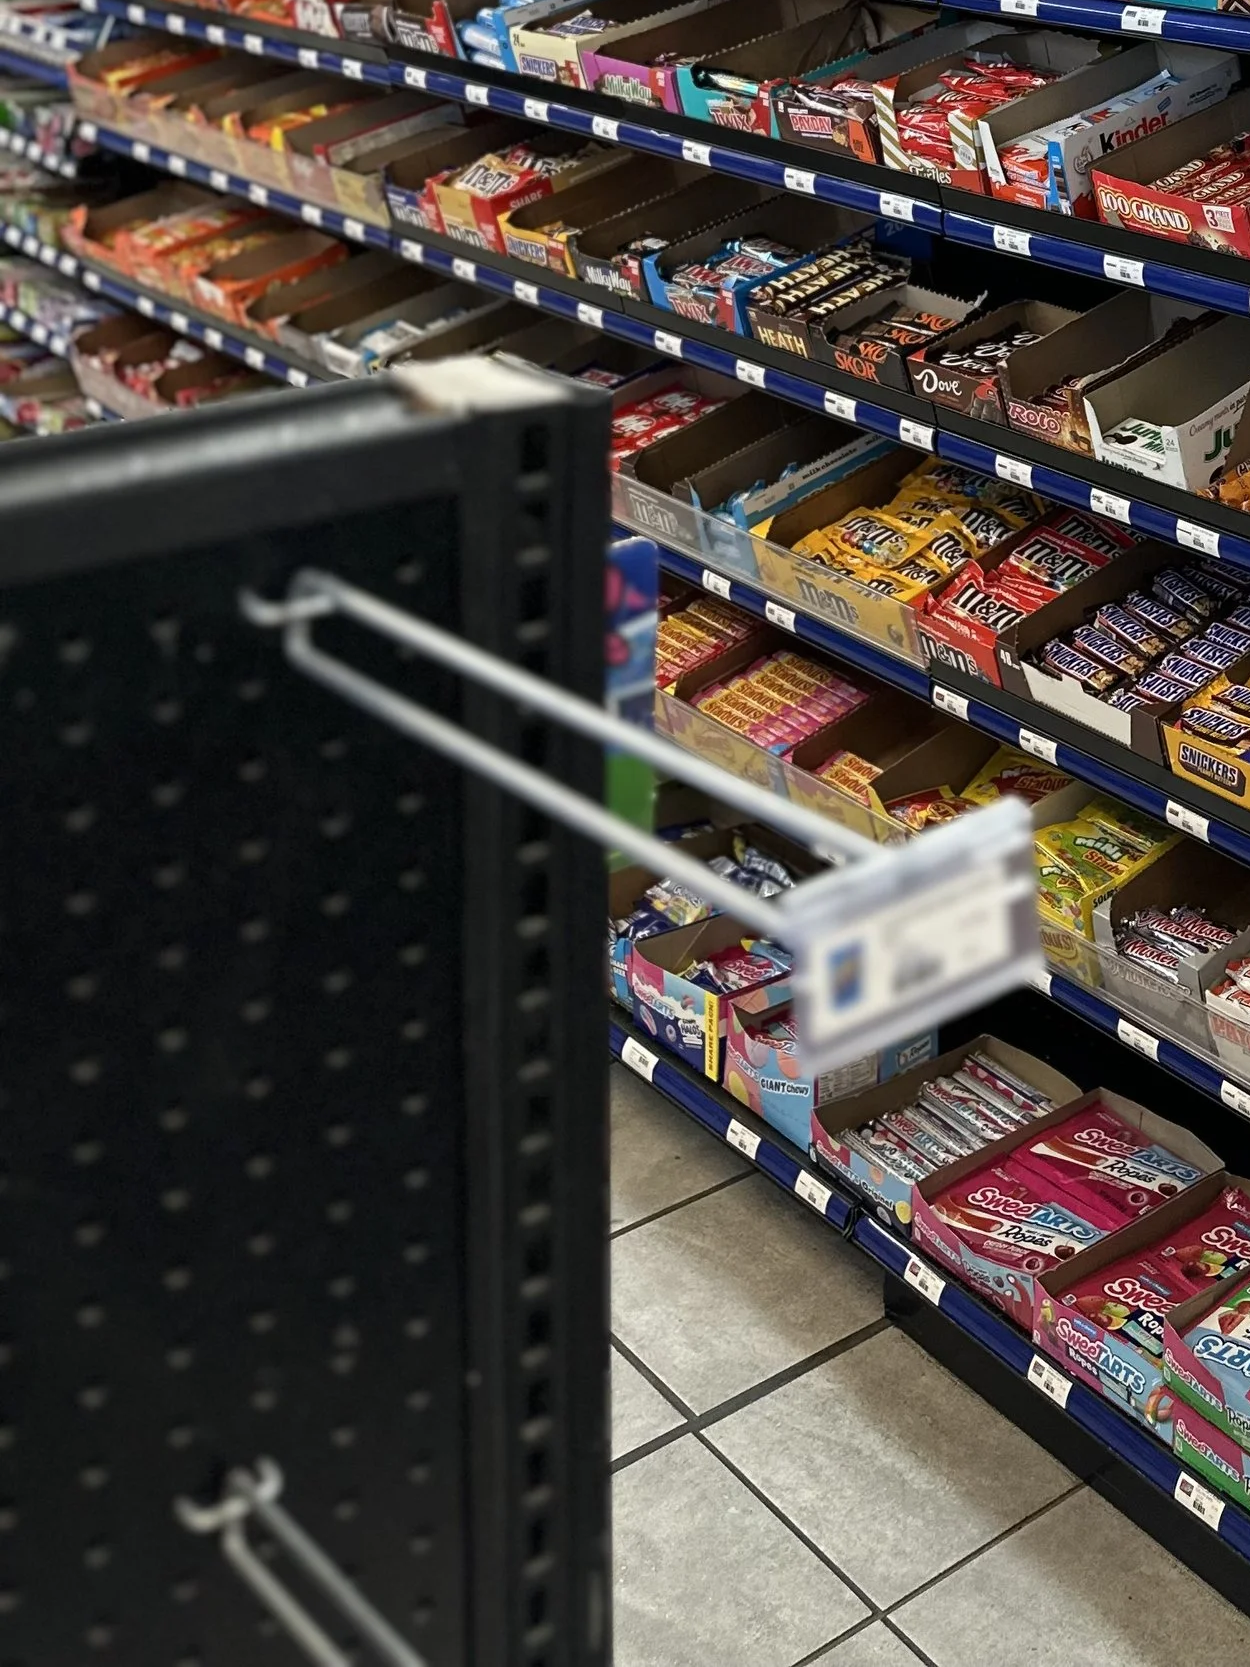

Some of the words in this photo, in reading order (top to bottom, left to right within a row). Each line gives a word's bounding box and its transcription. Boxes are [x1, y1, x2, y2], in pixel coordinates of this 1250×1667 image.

[520, 55, 556, 78] SNICKERS
[1099, 187, 1130, 215] 100
[1130, 201, 1191, 233] GRAND
[1205, 208, 1218, 230] 3
[758, 326, 805, 359] HEATH
[834, 350, 880, 384] SKOR
[1101, 605, 1151, 643] SNICKERS
[1048, 643, 1097, 676] SNICKERS
[1075, 625, 1128, 662] SNICKERS
[1184, 707, 1248, 737] SNICKERS
[1181, 743, 1238, 785] SNICKERS
[760, 1078, 787, 1093] GIANT
[787, 1084, 809, 1096] chewy
[1103, 1159, 1156, 1185] Ropes
[1000, 1225, 1052, 1249] Ropes
